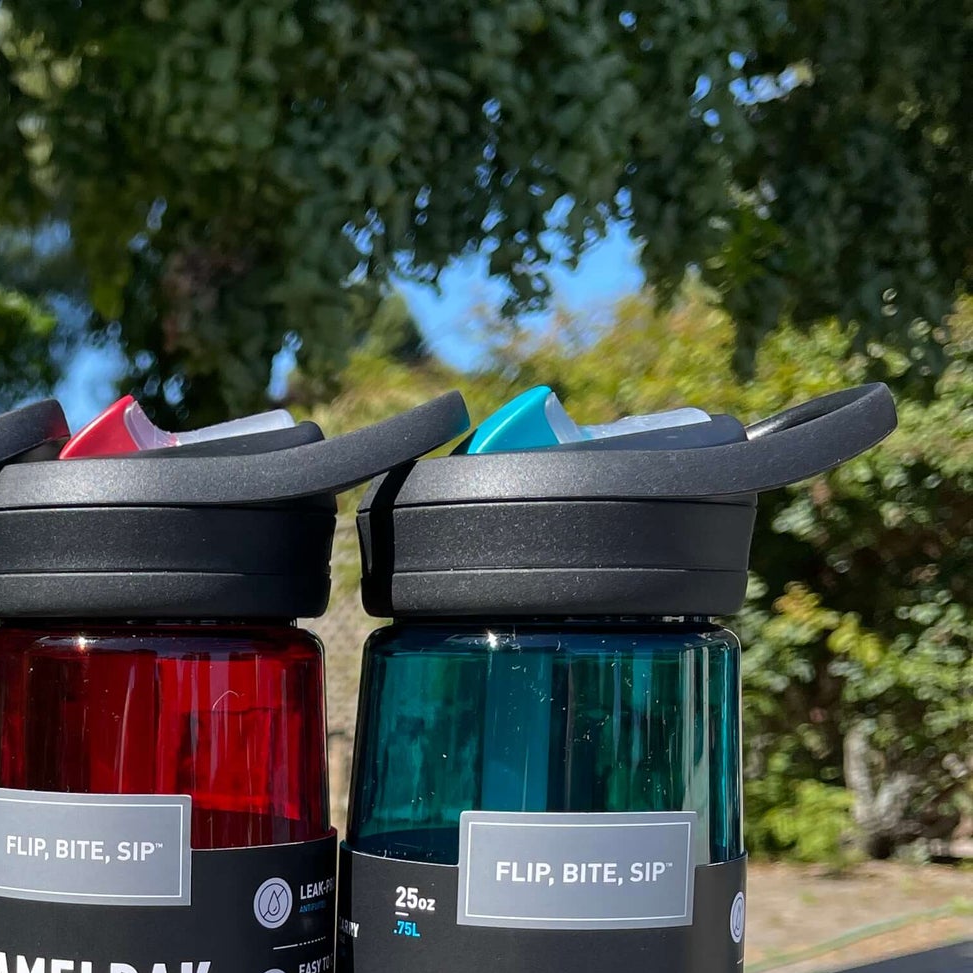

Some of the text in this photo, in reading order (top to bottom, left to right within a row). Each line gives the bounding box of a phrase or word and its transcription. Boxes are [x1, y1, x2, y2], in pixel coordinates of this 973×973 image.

[6, 835, 49, 860] FLIP,
[55, 838, 110, 864] BITE,
[496, 861, 555, 887] FLIP,
[562, 863, 623, 887] BITE,
[395, 886, 436, 911] 25oz
[393, 920, 421, 938] .75L
